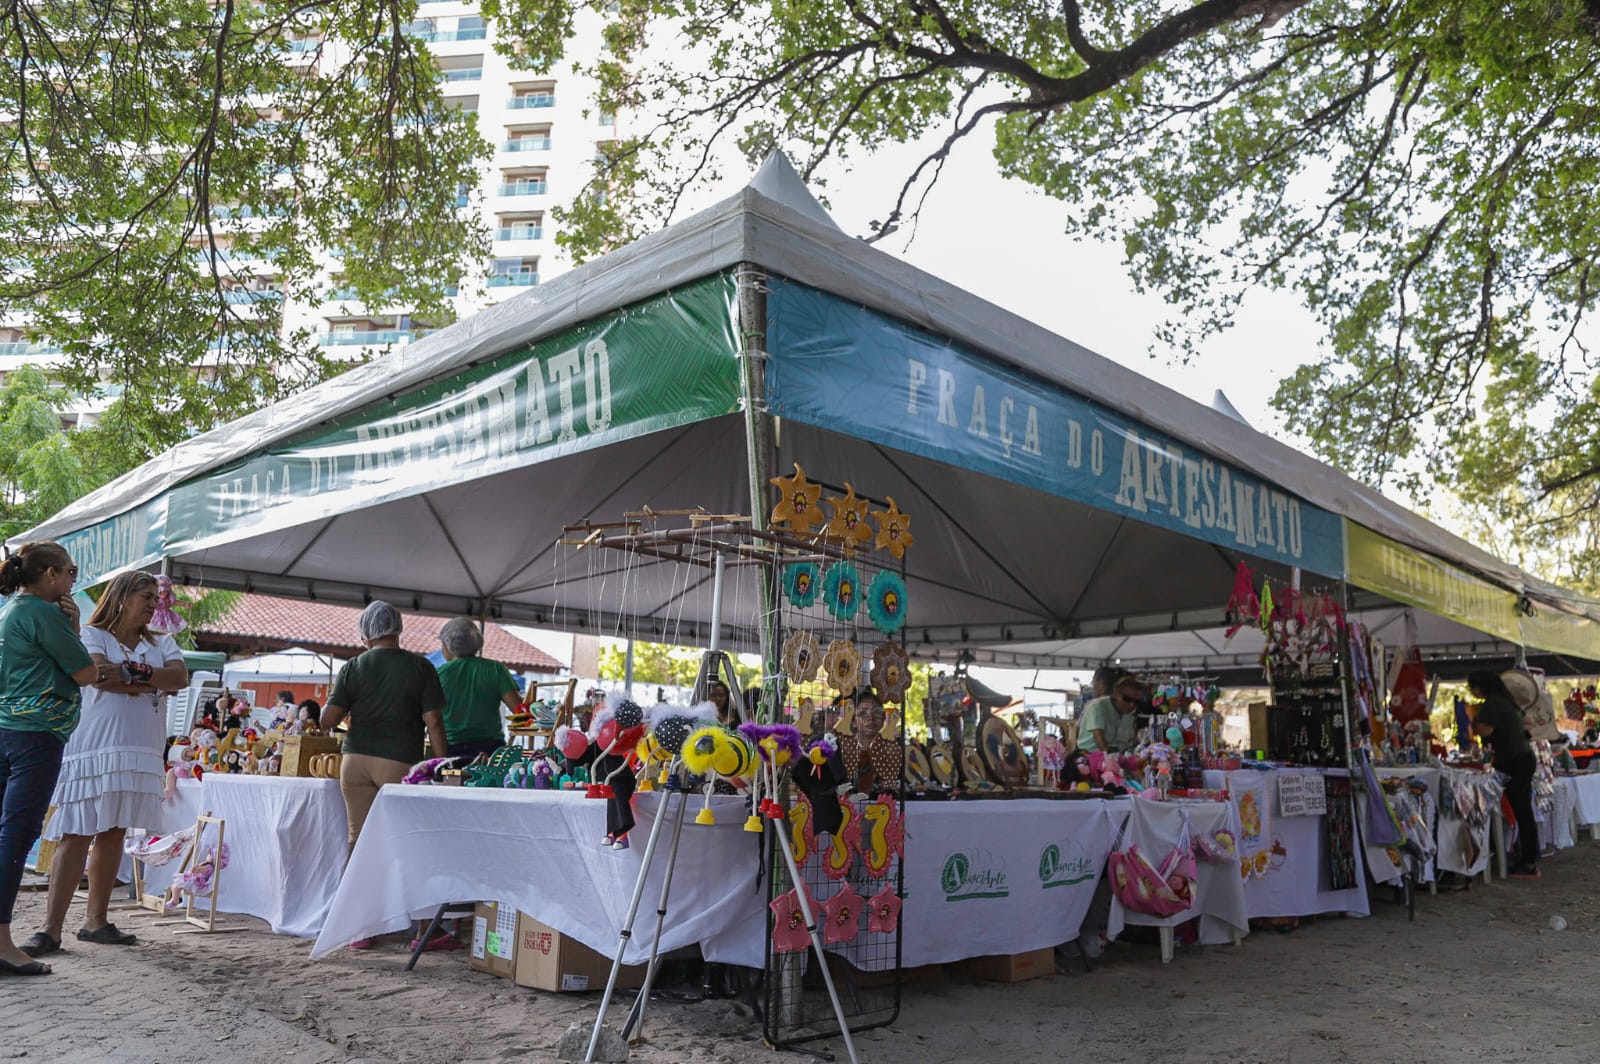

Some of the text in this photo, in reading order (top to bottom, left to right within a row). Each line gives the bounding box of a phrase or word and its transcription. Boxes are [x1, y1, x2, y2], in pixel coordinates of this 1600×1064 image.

[907, 358, 1303, 558] PRAÇA DO ARTESANATO
